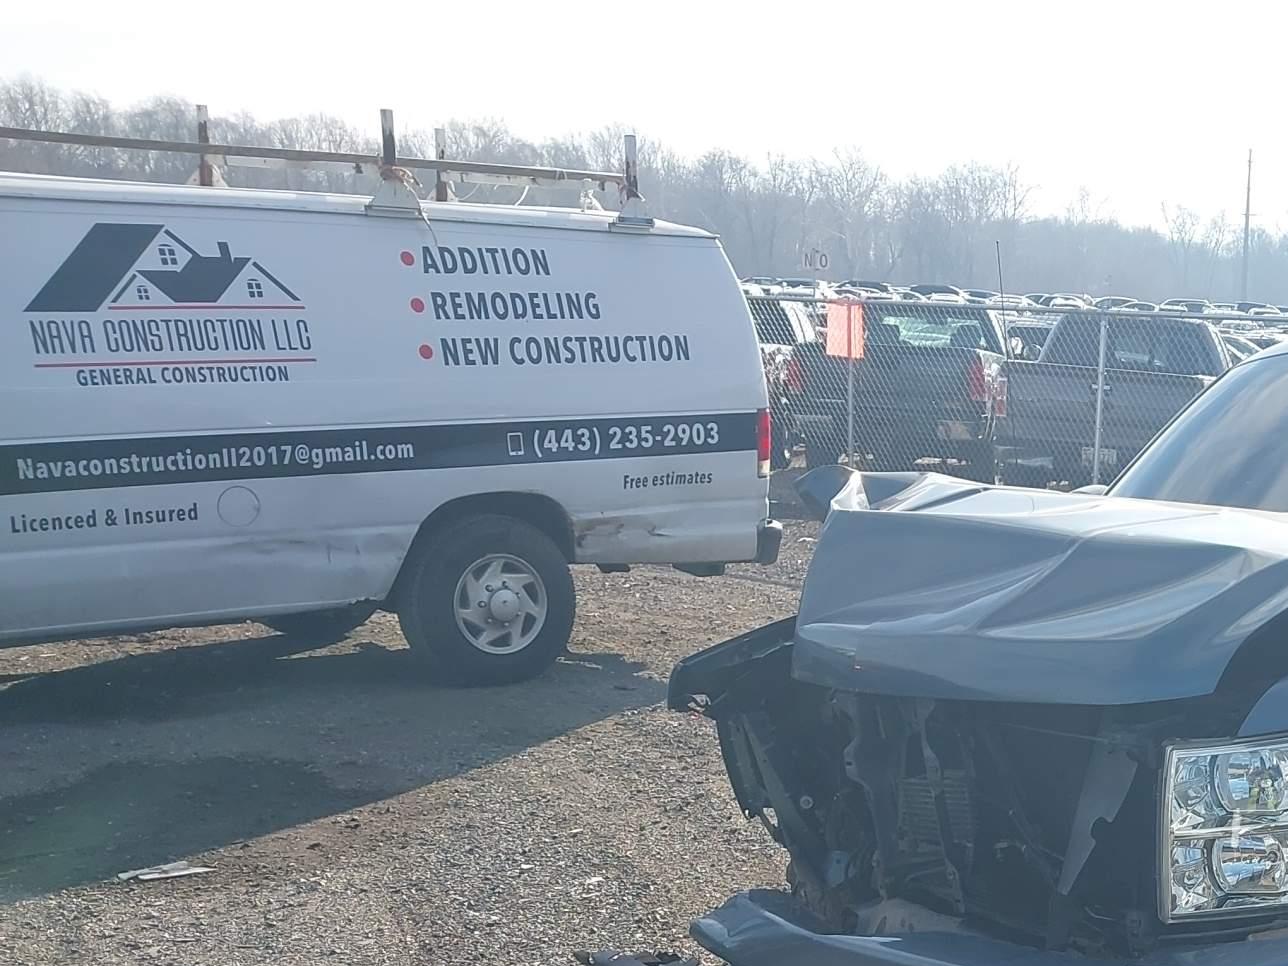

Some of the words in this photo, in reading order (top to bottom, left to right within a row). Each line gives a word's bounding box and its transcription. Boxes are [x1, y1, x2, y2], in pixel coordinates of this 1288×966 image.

[422, 246, 551, 276] ADDITION
[430, 291, 601, 320] REMODELING
[29, 319, 96, 354] NAVA
[103, 319, 266, 353] CONSTRUCTION
[272, 318, 312, 351] LLC
[440, 337, 499, 366] NEW
[509, 335, 690, 365] CONSTRUCTION
[76, 367, 156, 387] GENERAL
[161, 365, 289, 384] CONSTRUCTION
[533, 427, 601, 458] (443)
[608, 422, 719, 449] 235-2903
[623, 474, 649, 490] Free
[652, 471, 713, 487] estimates
[10, 509, 97, 534] Licenced
[104, 509, 118, 527] &
[124, 502, 199, 525] Insured
